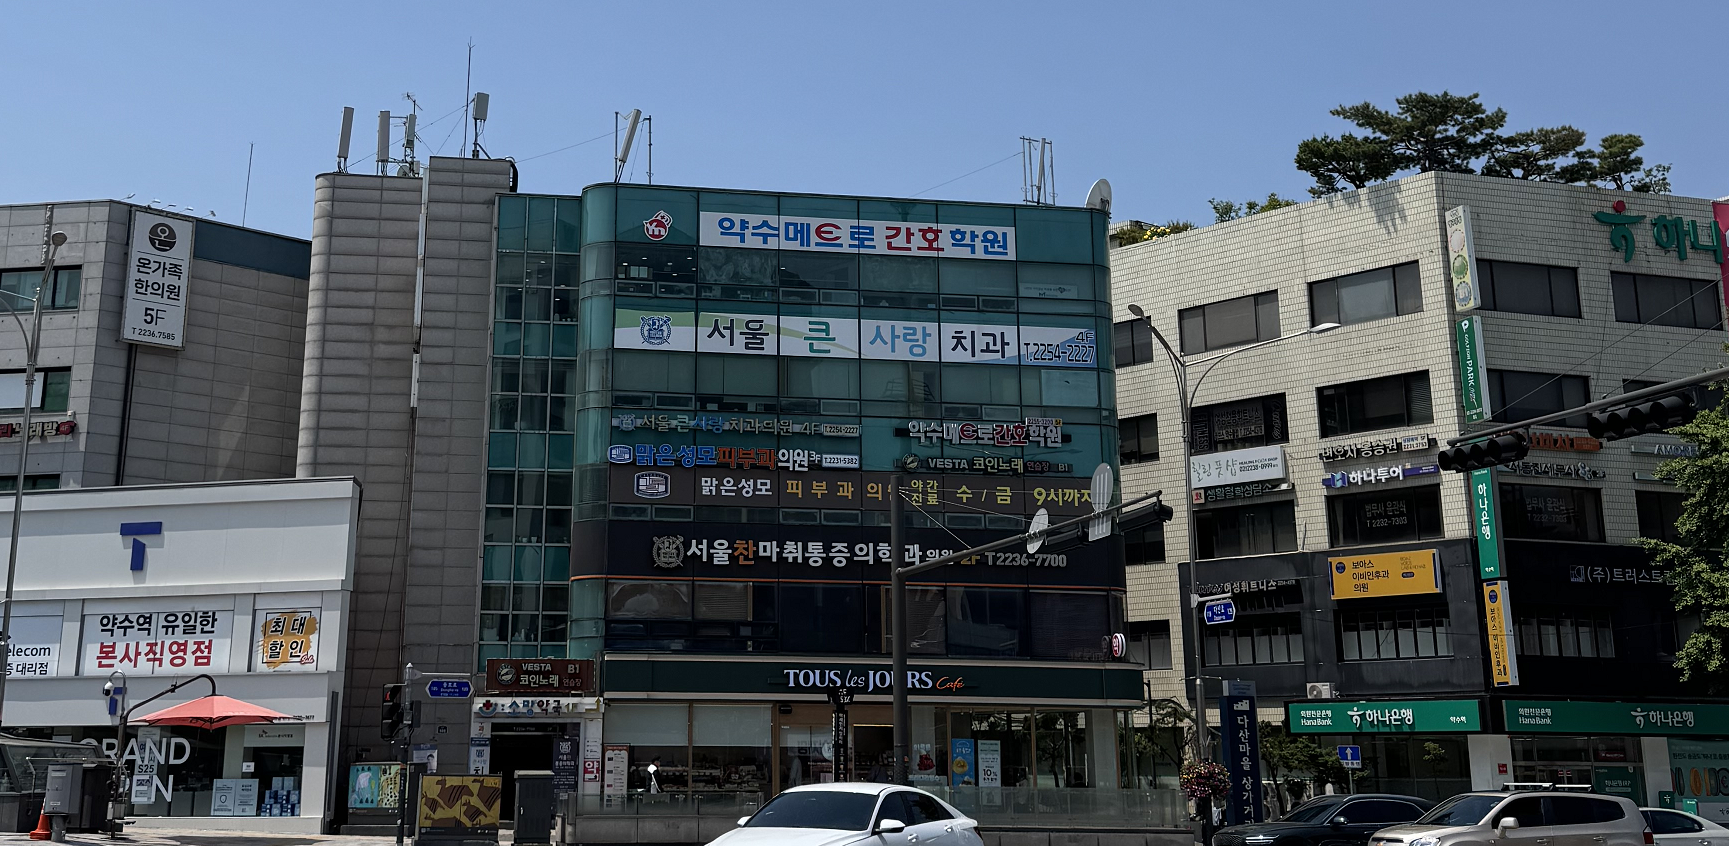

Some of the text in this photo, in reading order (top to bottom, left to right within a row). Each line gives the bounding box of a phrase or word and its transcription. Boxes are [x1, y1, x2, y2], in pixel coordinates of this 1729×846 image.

[1651, 214, 1723, 264] 하나
[136, 257, 183, 281] 온가족
[134, 278, 181, 301] 한의원
[143, 307, 167, 326] 5F
[138, 328, 175, 341] 2236.7585
[707, 318, 1010, 359] 서울 큰 사랑 치과
[1075, 331, 1094, 343] 4F
[1024, 342, 1095, 363] T.2254-2227
[1466, 359, 1475, 387] PARK
[640, 413, 671, 432] 서울
[676, 415, 690, 433] 큰
[729, 417, 793, 436] 치과의원
[800, 422, 821, 435] 4F
[808, 450, 821, 463] 3F
[1322, 444, 1357, 462] 변호사
[928, 458, 968, 469] VESTA
[973, 456, 1024, 473] 코인노래
[1058, 463, 1068, 471] B1
[1349, 465, 1403, 485] 하나투어
[701, 477, 773, 498] 맑은성모
[956, 485, 972, 502] 수
[995, 486, 1012, 504] 금
[1477, 483, 1491, 540] 하나은행
[1352, 559, 1375, 570] 보아스
[1352, 569, 1390, 581] 이비인후과
[1223, 579, 1277, 594] 여성휘트니스
[1354, 582, 1369, 593] 의원
[99, 611, 218, 637] 약수역 유일한
[96, 639, 213, 668] 본사직영점
[16, 661, 49, 676] 대리점
[522, 663, 580, 674] VESTA B1
[519, 674, 559, 688] 코인노래
[783, 669, 842, 687] TOUS
[845, 669, 865, 687] les
[507, 699, 578, 717] 소망약국 1F
[1365, 708, 1413, 725] 하나은행
[1301, 718, 1333, 726] Hana Bank
[1519, 716, 1552, 725] Hana Bank
[1648, 710, 1695, 727] 하나은행
[1237, 714, 1252, 771] 다산마을
[138, 764, 155, 773] S25
